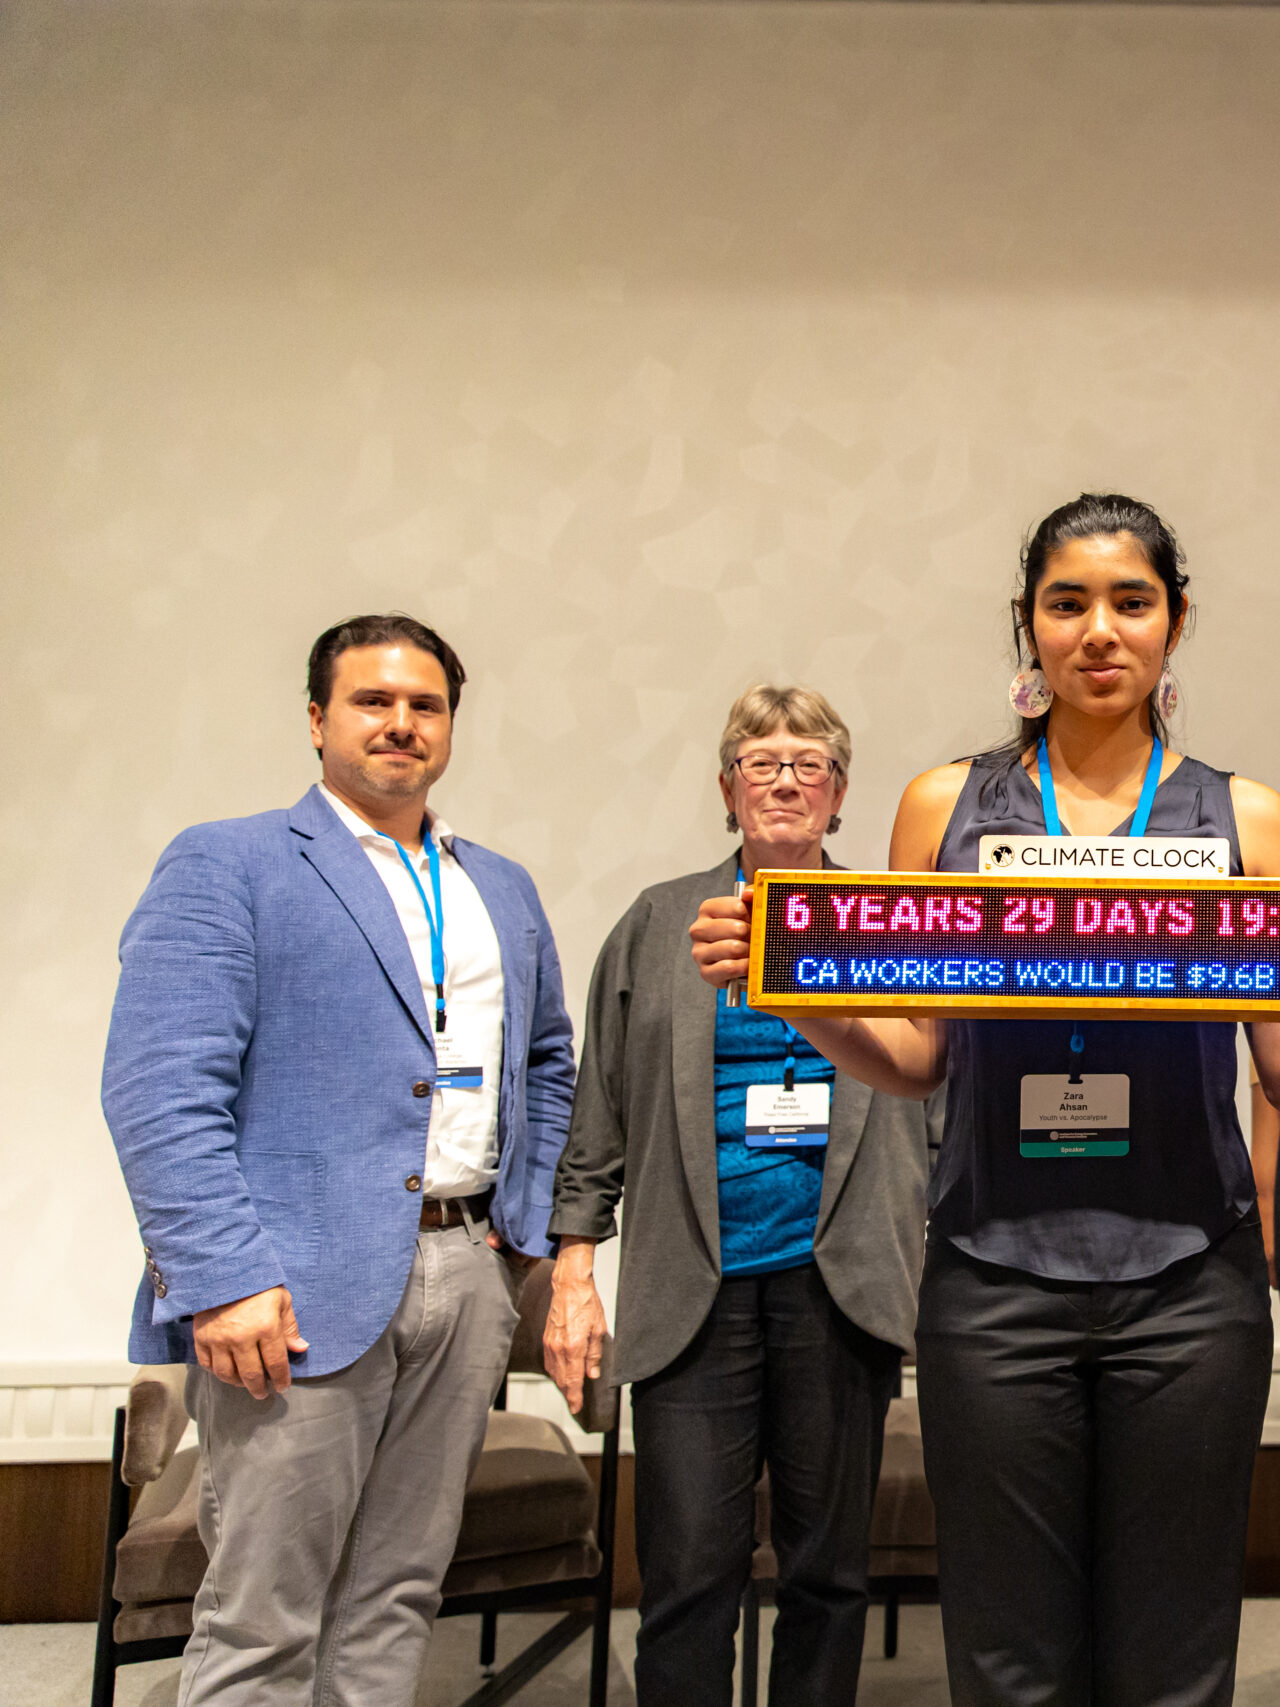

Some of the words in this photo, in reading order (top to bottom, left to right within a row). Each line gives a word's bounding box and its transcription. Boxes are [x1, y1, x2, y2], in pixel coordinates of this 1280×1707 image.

[1021, 847, 1125, 867] CLIMATE
[1133, 848, 1216, 868] CLOCK
[786, 894, 811, 930] 6
[830, 895, 983, 933] YEARS
[1003, 897, 1055, 933] 29
[1075, 898, 1194, 935] DAYS
[797, 958, 839, 984] CA
[850, 958, 1004, 986] WORKERS
[1016, 961, 1125, 987] WOULD
[1136, 962, 1175, 988] BE
[1187, 963, 1274, 989] $9.6B
[1063, 1092, 1084, 1100] Zara
[1059, 1103, 1088, 1111] Ahsan
[1070, 1114, 1108, 1122] Apocalypse
